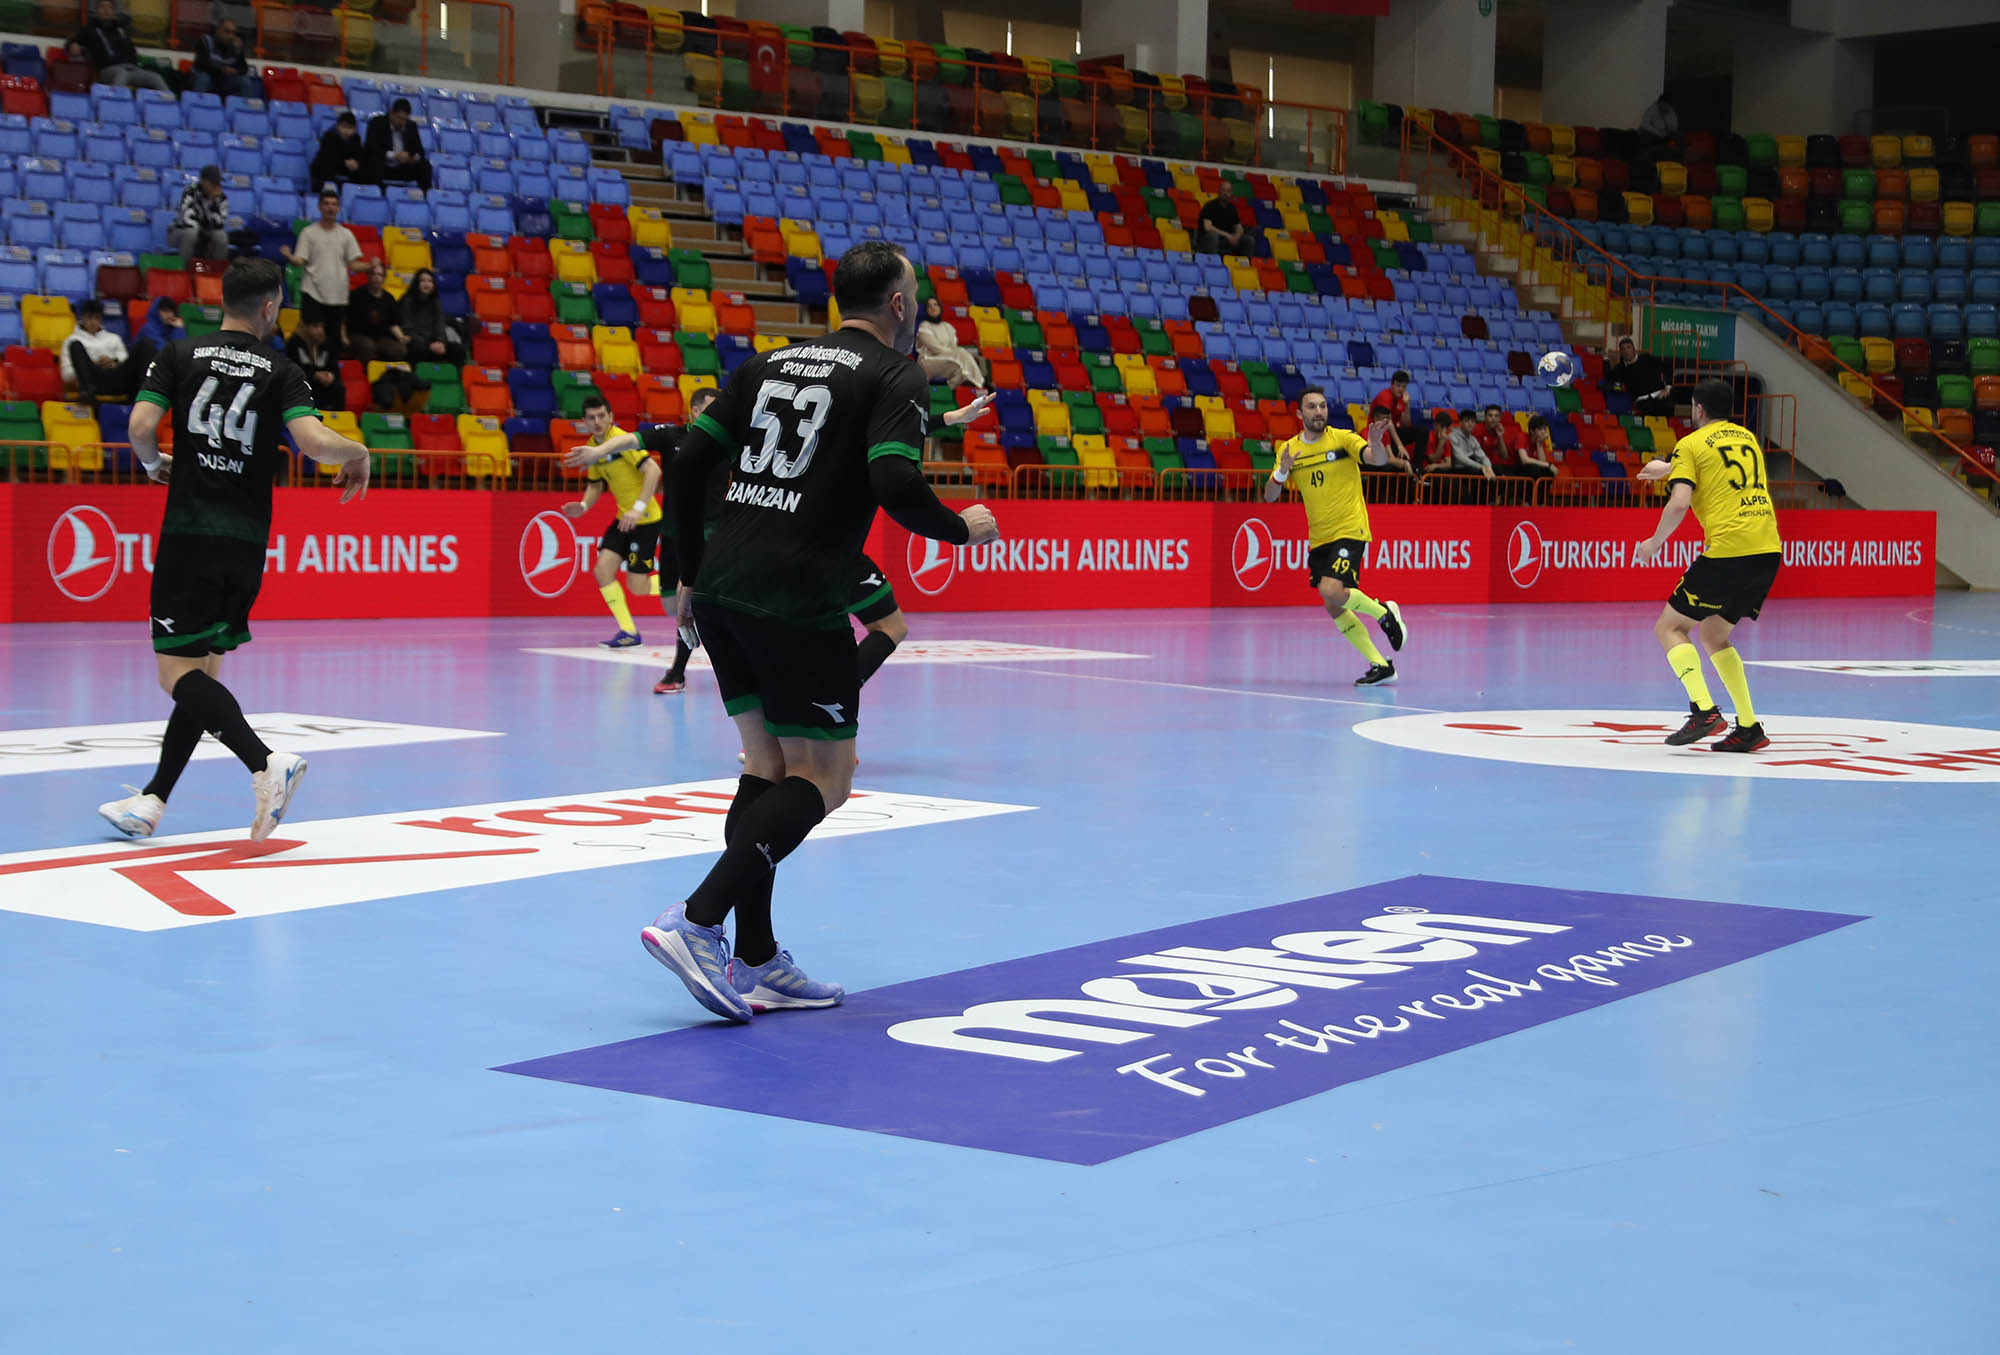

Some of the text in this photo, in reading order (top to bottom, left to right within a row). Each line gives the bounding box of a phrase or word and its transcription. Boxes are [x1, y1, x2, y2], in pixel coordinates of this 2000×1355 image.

[1695, 323, 1719, 337] TAKIM
[780, 360, 836, 378] SPOR KULÜBÜ
[187, 376, 258, 456] 44
[740, 379, 834, 479] 53
[1310, 470, 1324, 489] 49
[1716, 444, 1766, 491] 52
[725, 481, 802, 513] RAMAZAN
[1740, 495, 1769, 507] ALPER
[297, 534, 459, 573] AIRLINES
[1076, 538, 1190, 571] AIRLINES
[1332, 557, 1350, 575] 49
[1375, 539, 1471, 569] AIRLINES
[1541, 540, 1626, 568] TURKISH
[1781, 540, 1922, 567] URKISH AIRLINES
[887, 912, 1573, 1062] molten
[1116, 930, 1694, 1097] For the real game
